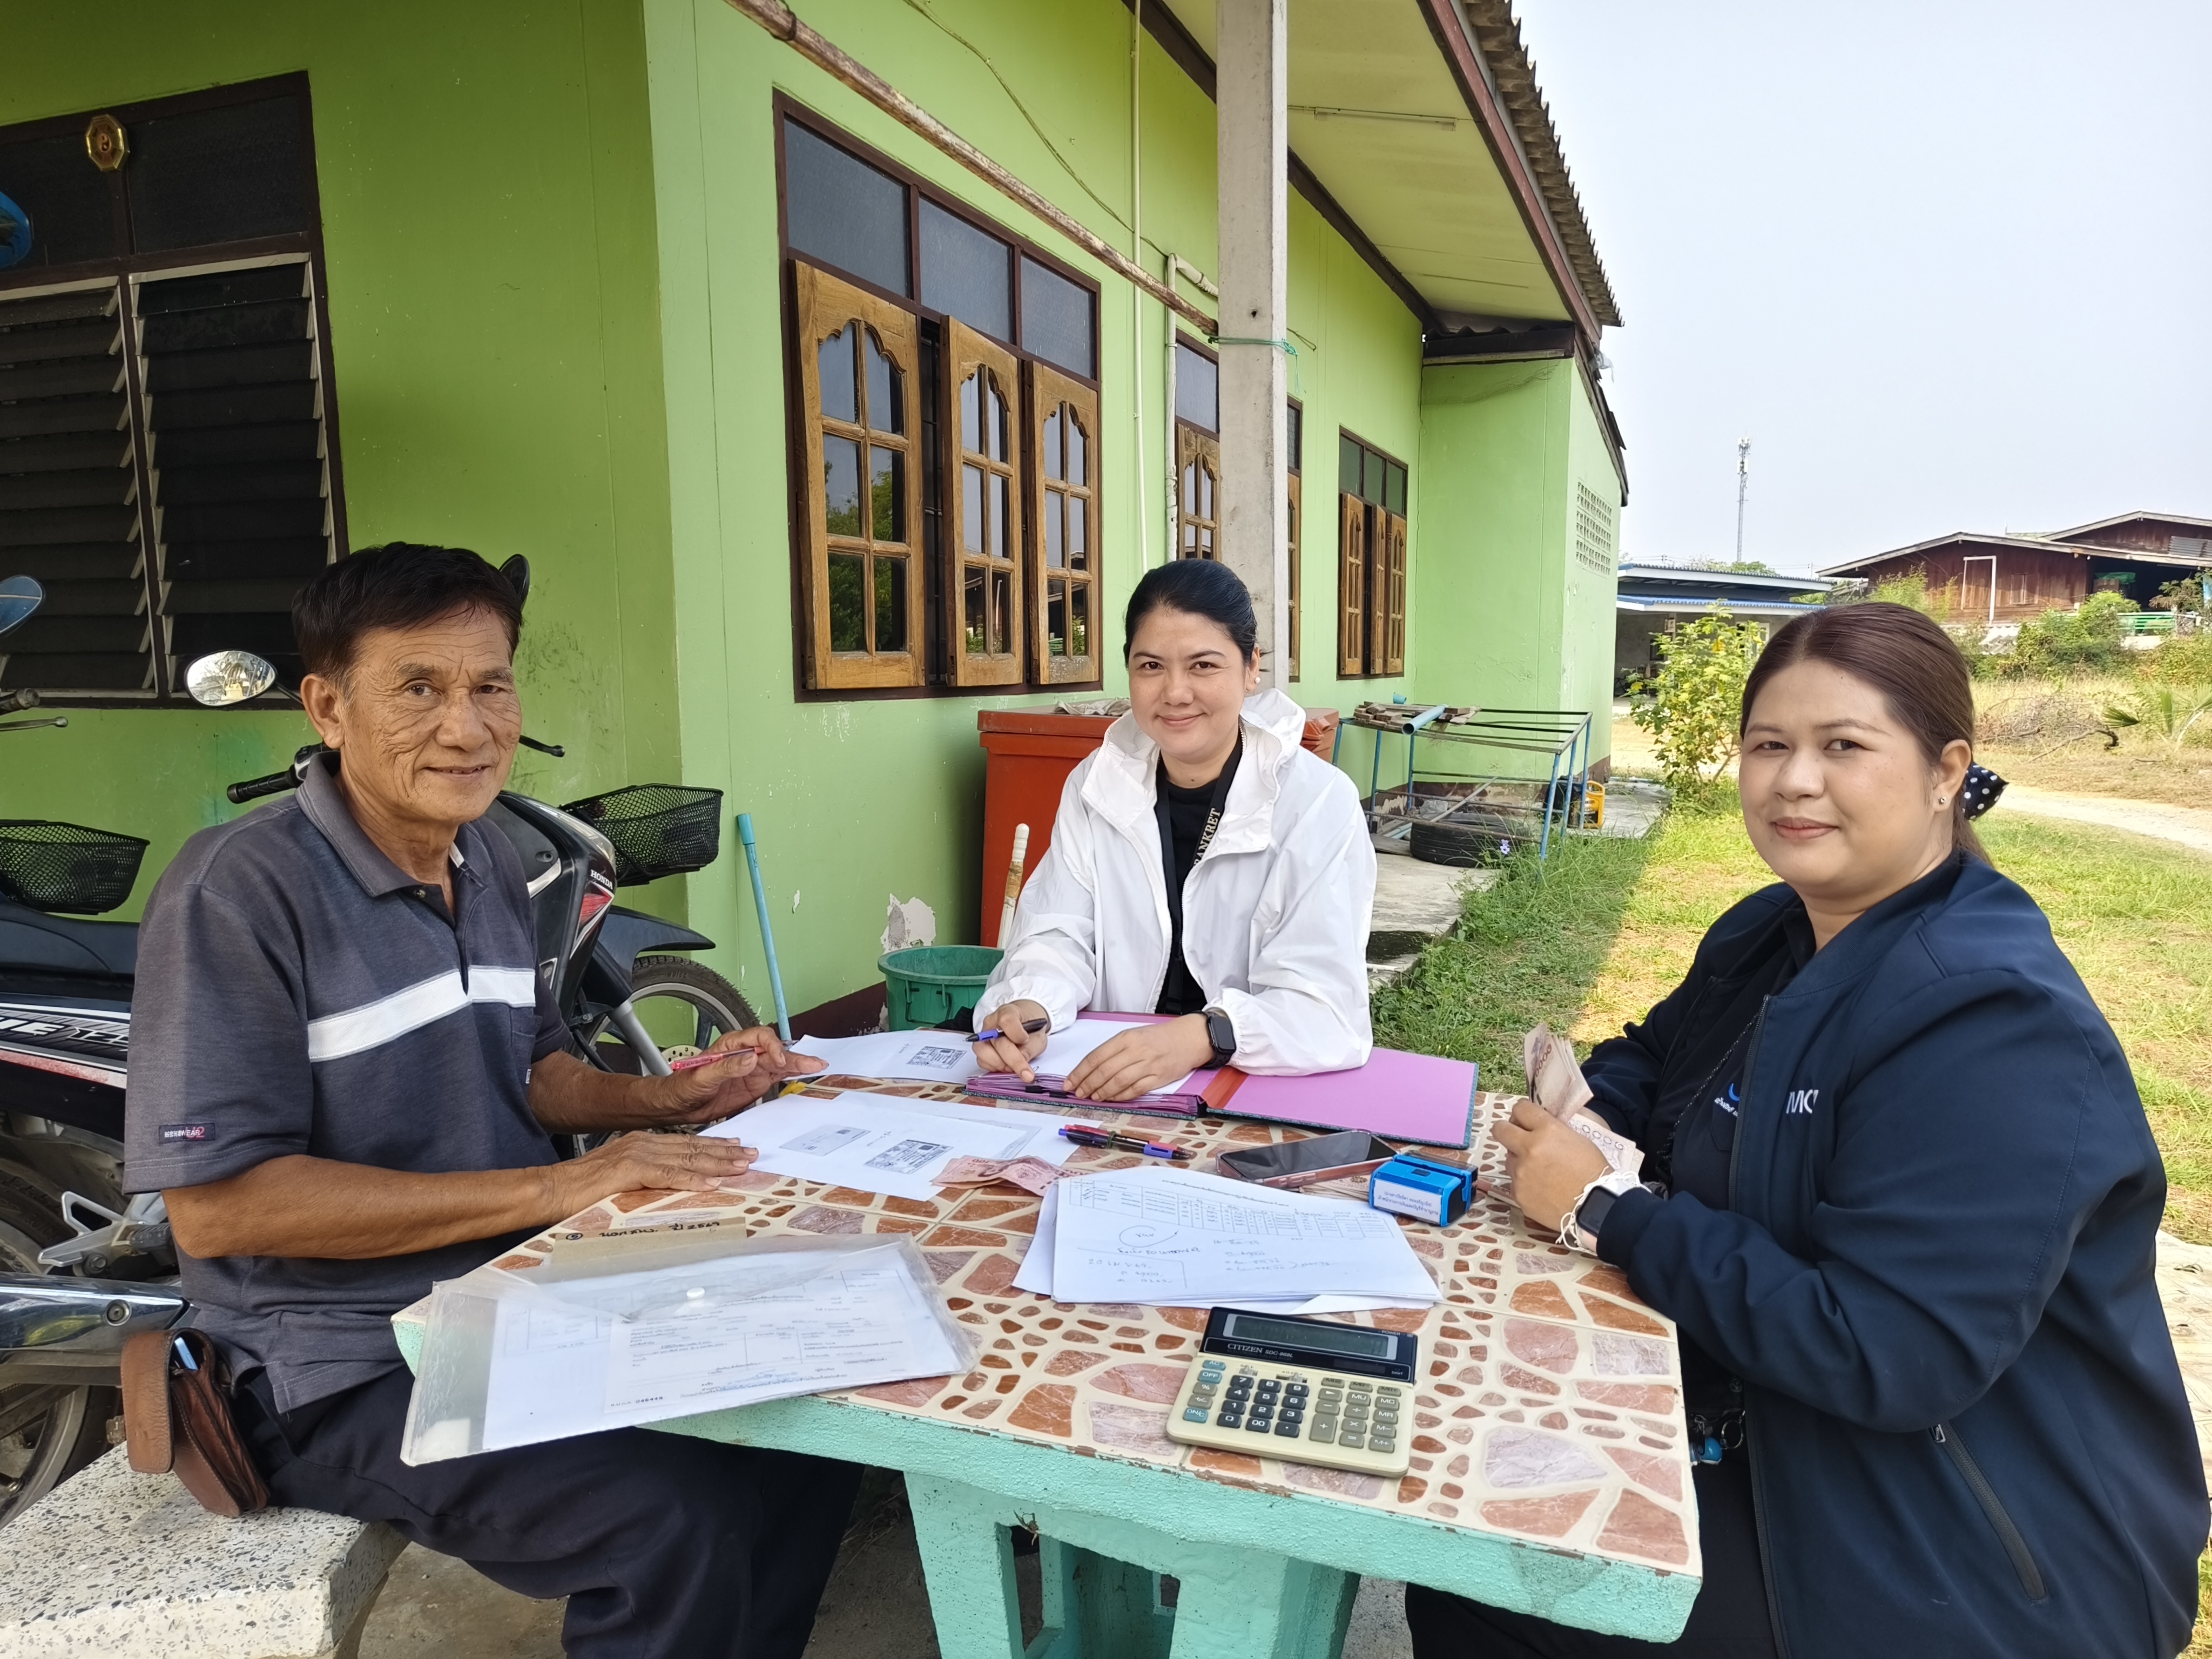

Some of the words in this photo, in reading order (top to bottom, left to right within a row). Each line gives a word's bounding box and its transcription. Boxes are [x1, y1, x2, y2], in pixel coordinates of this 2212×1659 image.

[590, 869, 613, 890] HONDA
[1227, 1343, 1263, 1354] CITIZEN
[1265, 1349, 1294, 1358] SDC-868L
[1186, 1409, 1205, 1418] ON/C
